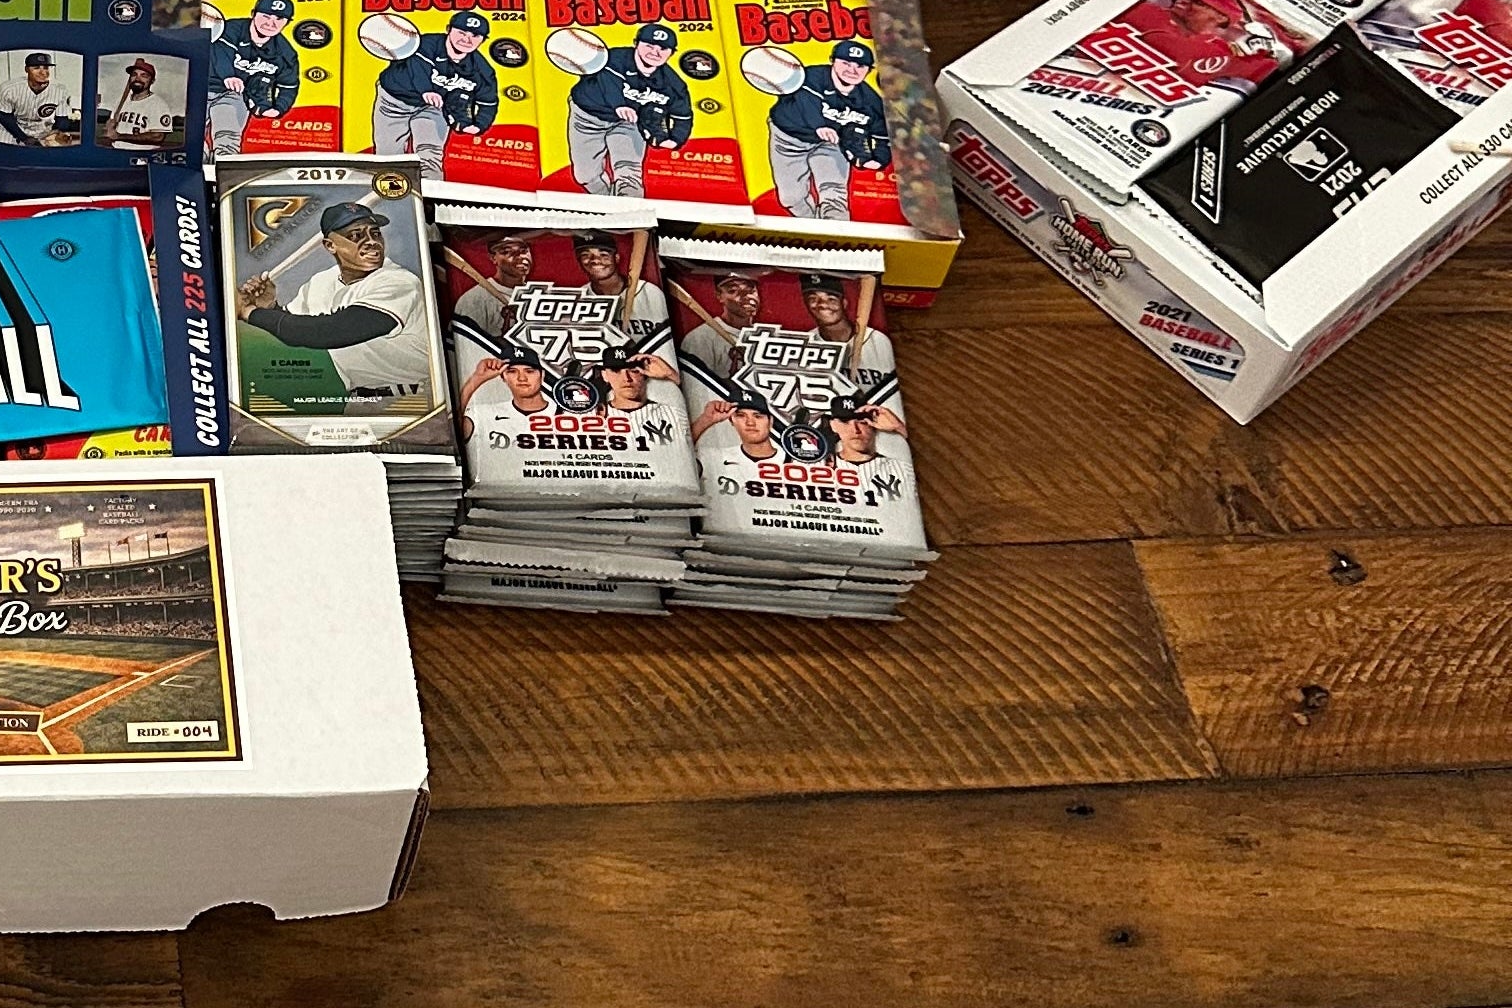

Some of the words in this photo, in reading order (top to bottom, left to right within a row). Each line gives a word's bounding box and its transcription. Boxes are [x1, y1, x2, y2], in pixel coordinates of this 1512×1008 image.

[492, 12, 527, 21] 2024
[679, 22, 714, 33] 2024
[1297, 89, 1340, 125] HOBBY
[1235, 122, 1299, 175] EXCLUSIVE
[297, 168, 347, 181] 2019
[1317, 159, 1364, 198] 2021
[1419, 164, 1465, 205] COLLECT
[1461, 151, 1484, 173] ALL
[1478, 134, 1503, 158] 330
[176, 195, 203, 269] CARDS!
[182, 272, 206, 312] 225
[1142, 299, 1193, 323] 2021
[186, 317, 210, 354] ALL
[1137, 313, 1233, 350] BASEBALL
[189, 353, 220, 447] COLLECT
[528, 415, 632, 434] 2026
[757, 462, 860, 487] 2026
[135, 727, 169, 739] RIDE
